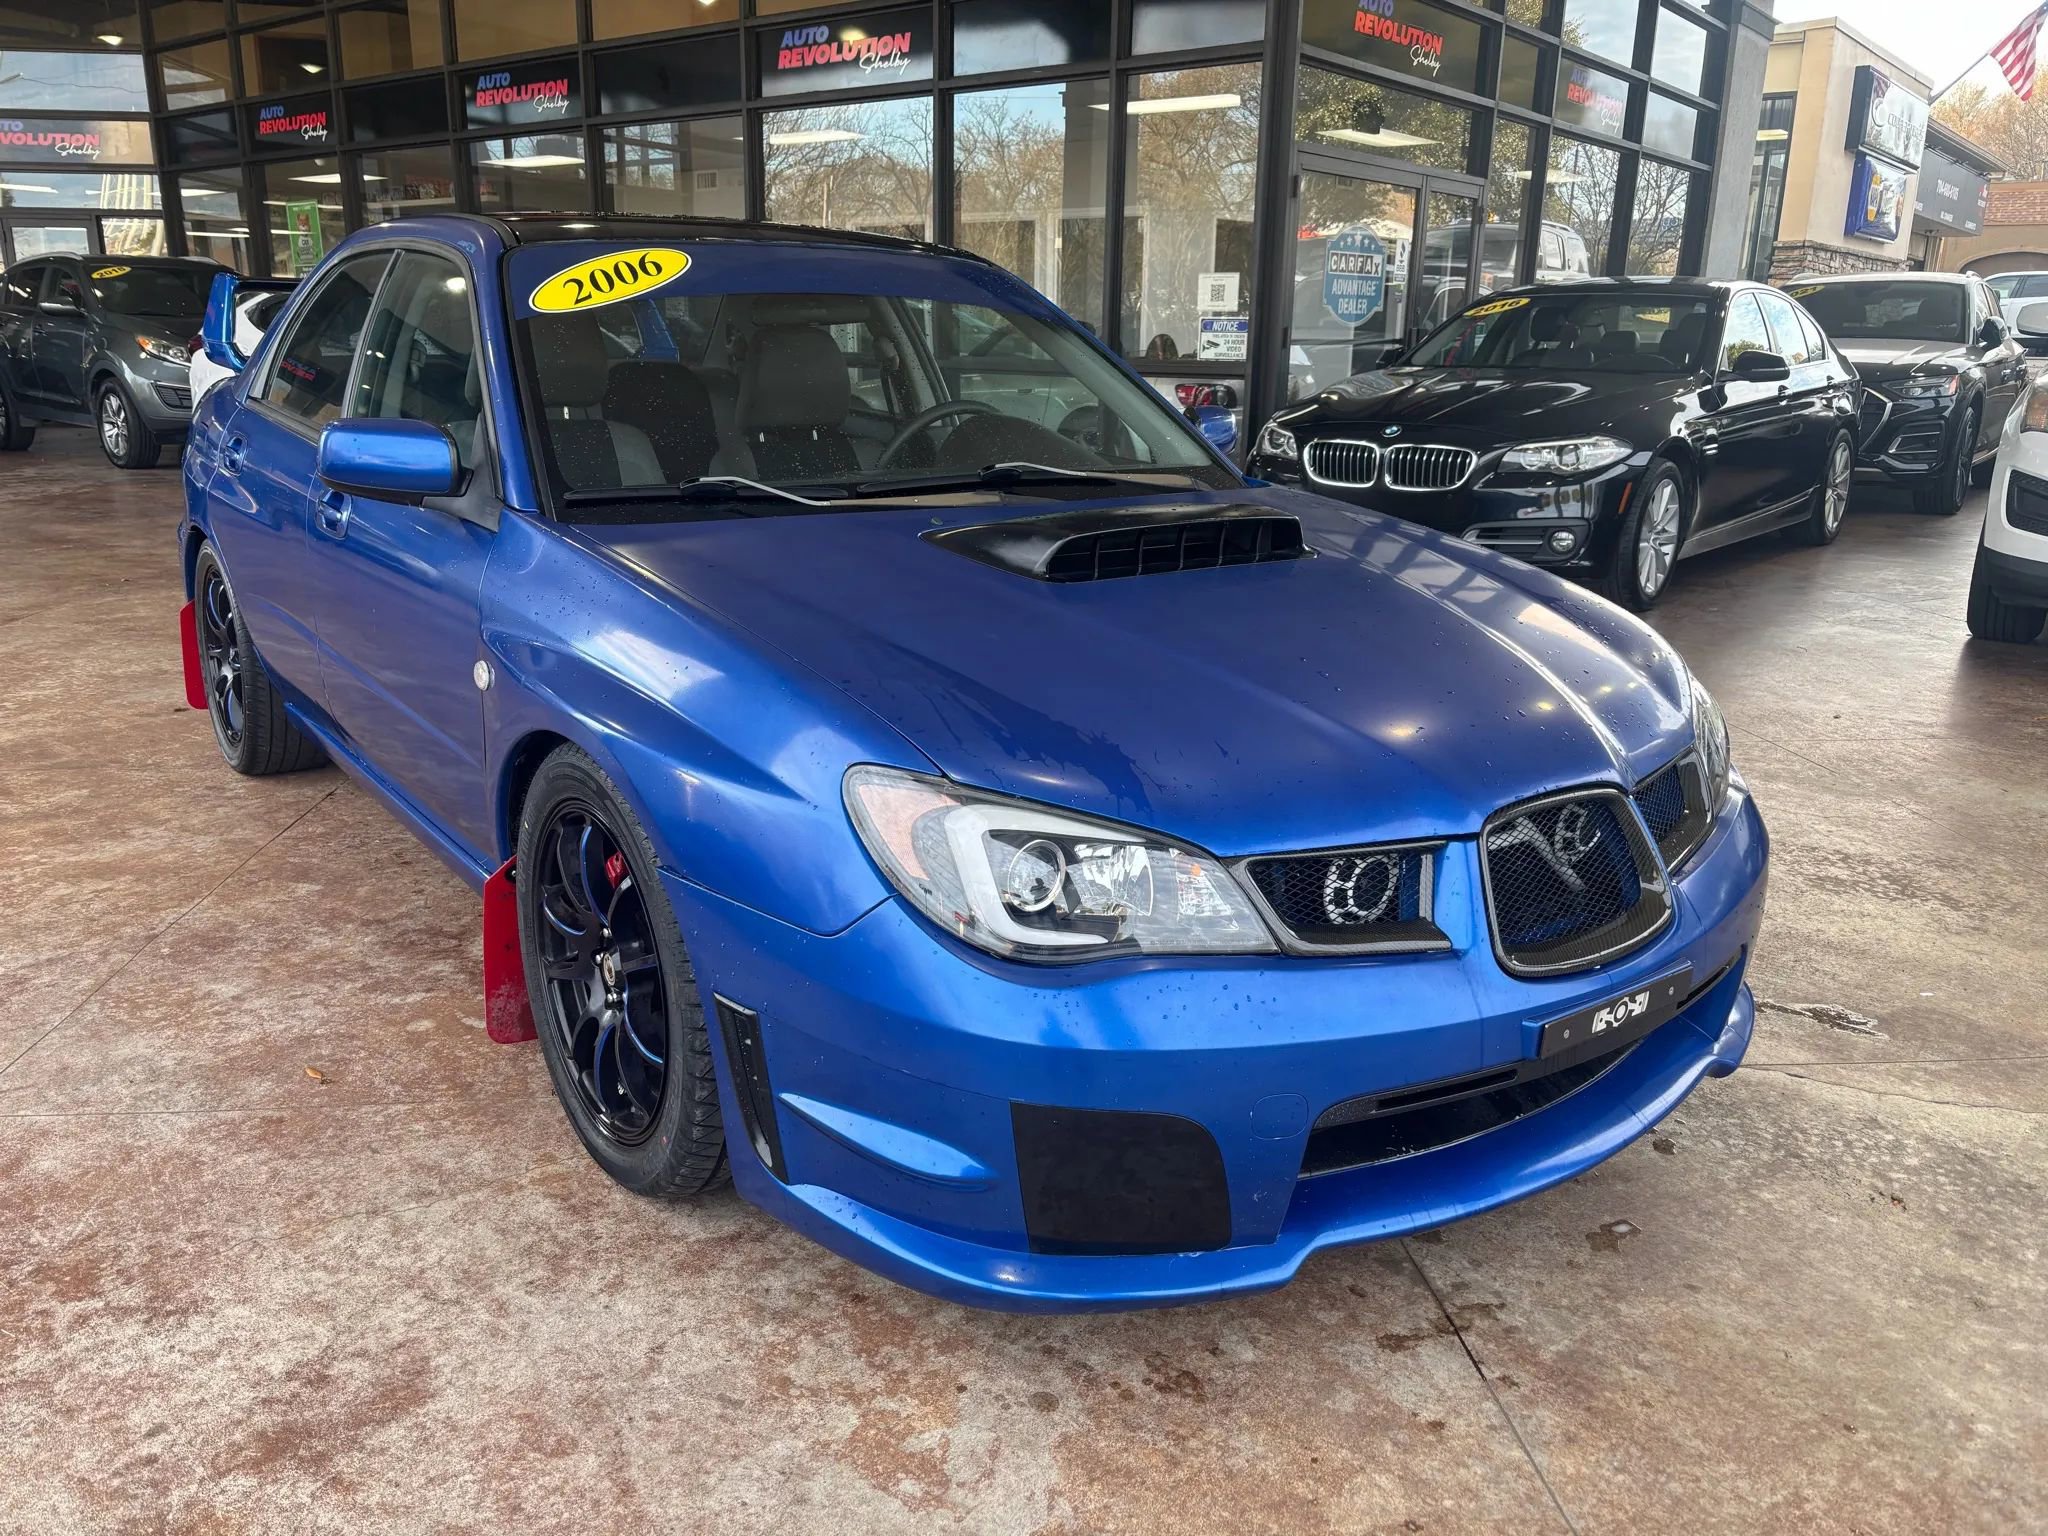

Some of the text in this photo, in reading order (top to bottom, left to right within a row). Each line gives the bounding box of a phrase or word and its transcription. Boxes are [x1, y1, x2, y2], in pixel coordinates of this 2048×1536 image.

[780, 25, 829, 48] AUTO
[1353, 10, 1444, 56] REVOLUTION
[777, 31, 912, 70] REVOLUTION
[1409, 44, 1441, 77] Shelby
[859, 47, 912, 76] Shelby
[477, 71, 511, 90] AUTO
[475, 79, 569, 108] REVOLUTION
[533, 91, 570, 115] Shelby
[260, 105, 285, 120] AUTO
[0, 120, 24, 131] TO
[259, 111, 327, 135] REVOLUTION
[301, 122, 329, 142] Shelby
[0, 132, 100, 146] VOLUTION
[55, 142, 101, 160] Shelby
[1330, 254, 1381, 276] CARFAX
[562, 252, 663, 306] 2006
[1331, 278, 1378, 297] ADVANTAGE
[1790, 285, 1818, 297] 021
[1338, 298, 1368, 315] DEALER
[1472, 299, 1522, 315] 2016
[1212, 320, 1239, 331] NOTICE
